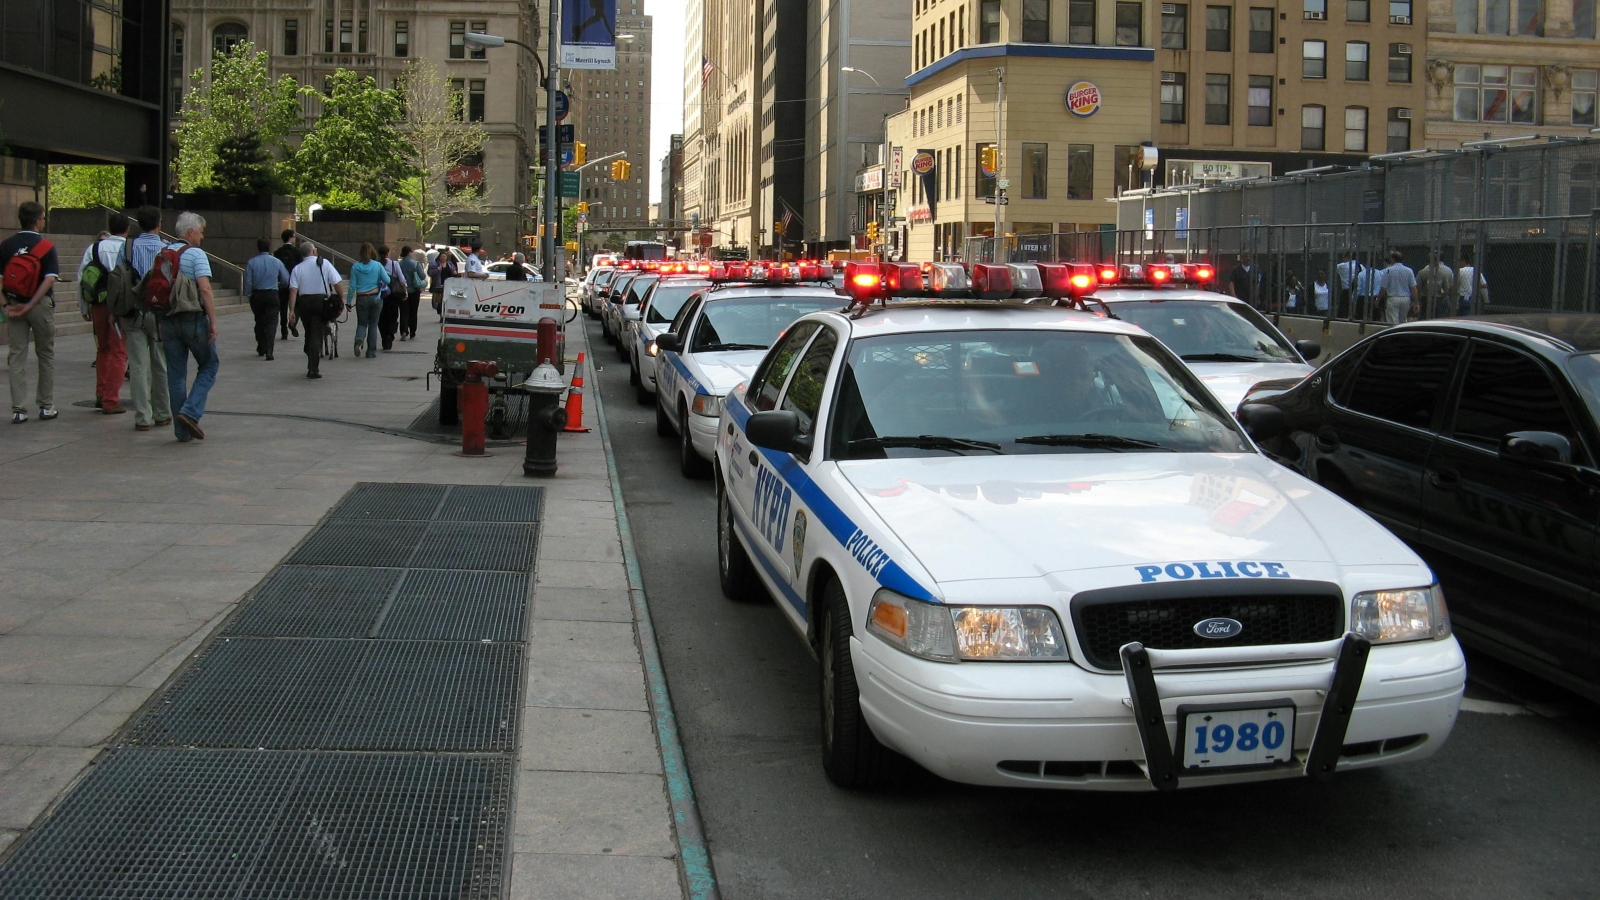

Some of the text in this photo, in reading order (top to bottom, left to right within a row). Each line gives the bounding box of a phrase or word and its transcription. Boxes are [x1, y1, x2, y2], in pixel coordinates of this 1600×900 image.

[1069, 87, 1097, 101] BURGER
[1070, 94, 1099, 111] KING
[915, 156, 932, 165] BURGER
[915, 160, 933, 170] KING
[475, 302, 525, 316] verizon
[752, 463, 792, 554] NYPD
[846, 529, 890, 578] POLICE
[1135, 561, 1290, 583] POLICE
[1206, 621, 1231, 635] Ford
[1194, 721, 1285, 755] 1980
